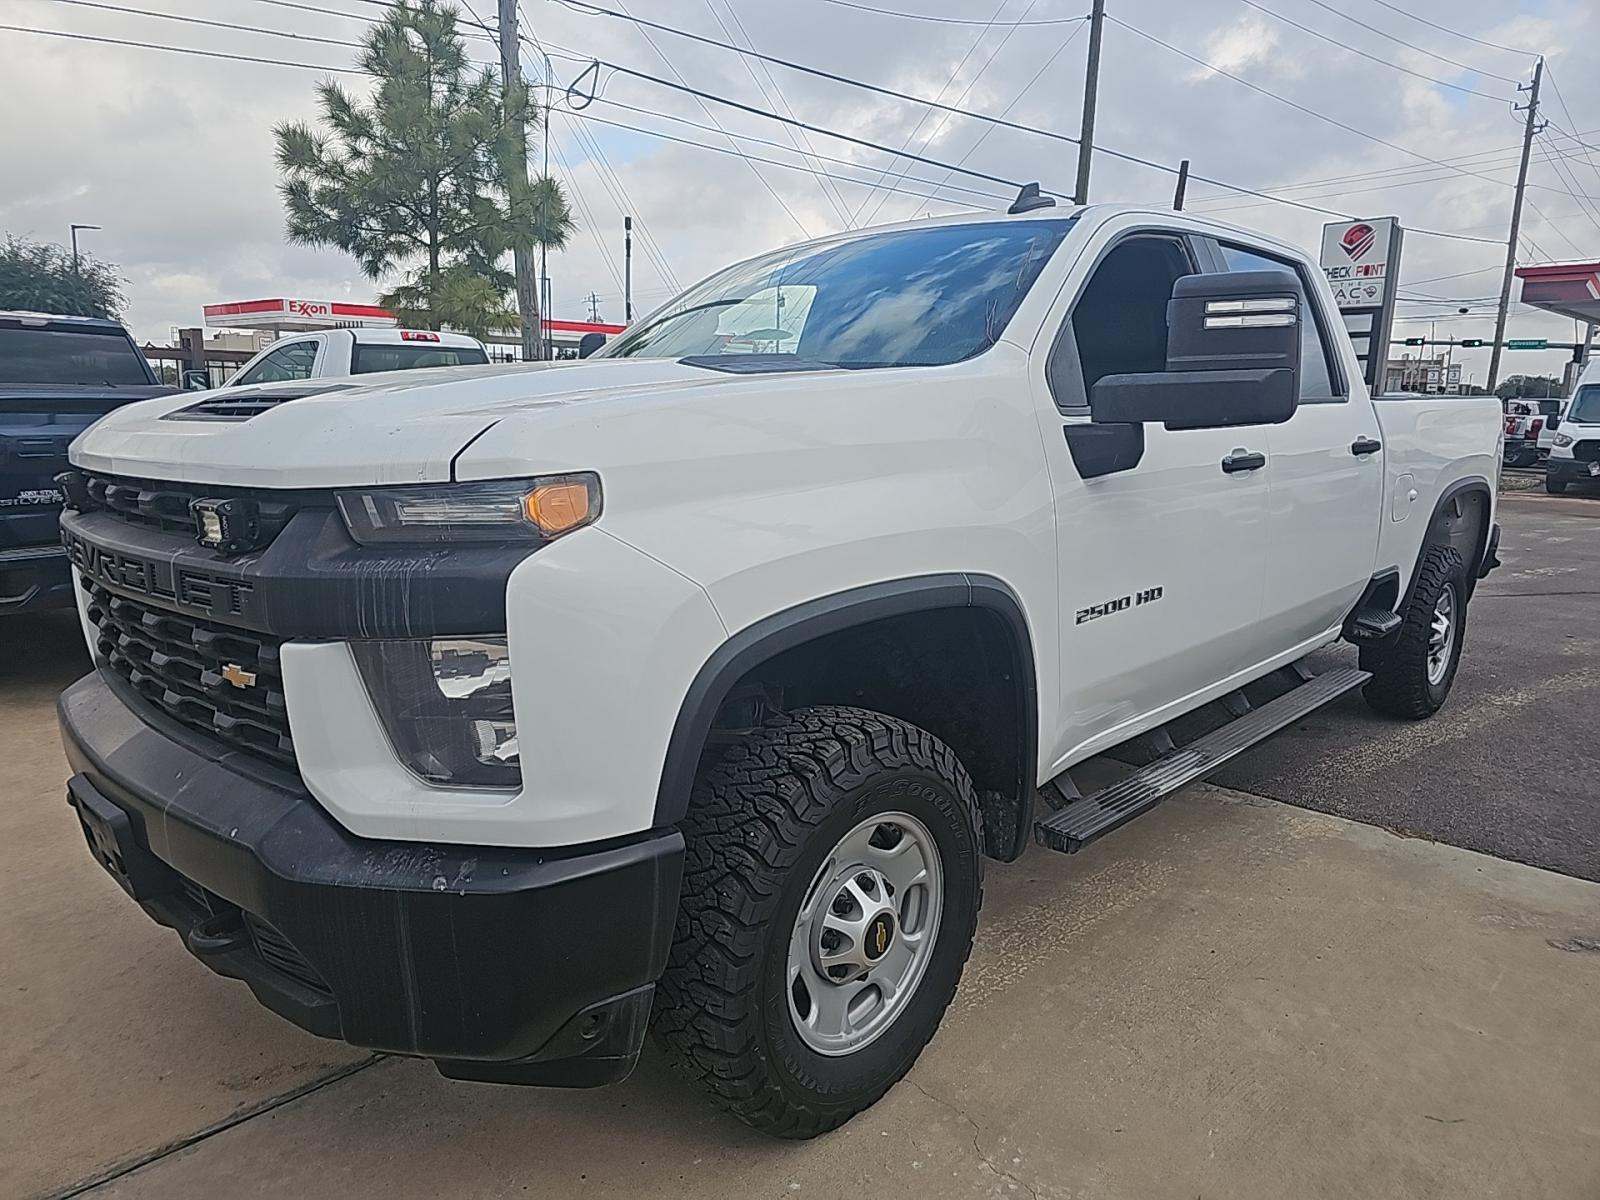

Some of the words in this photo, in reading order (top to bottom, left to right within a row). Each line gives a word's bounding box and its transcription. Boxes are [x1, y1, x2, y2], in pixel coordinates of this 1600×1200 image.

[1356, 264, 1386, 277] POINT
[289, 300, 328, 317] Exxon
[1075, 595, 1132, 626] 2500
[1135, 586, 1164, 606] HD
